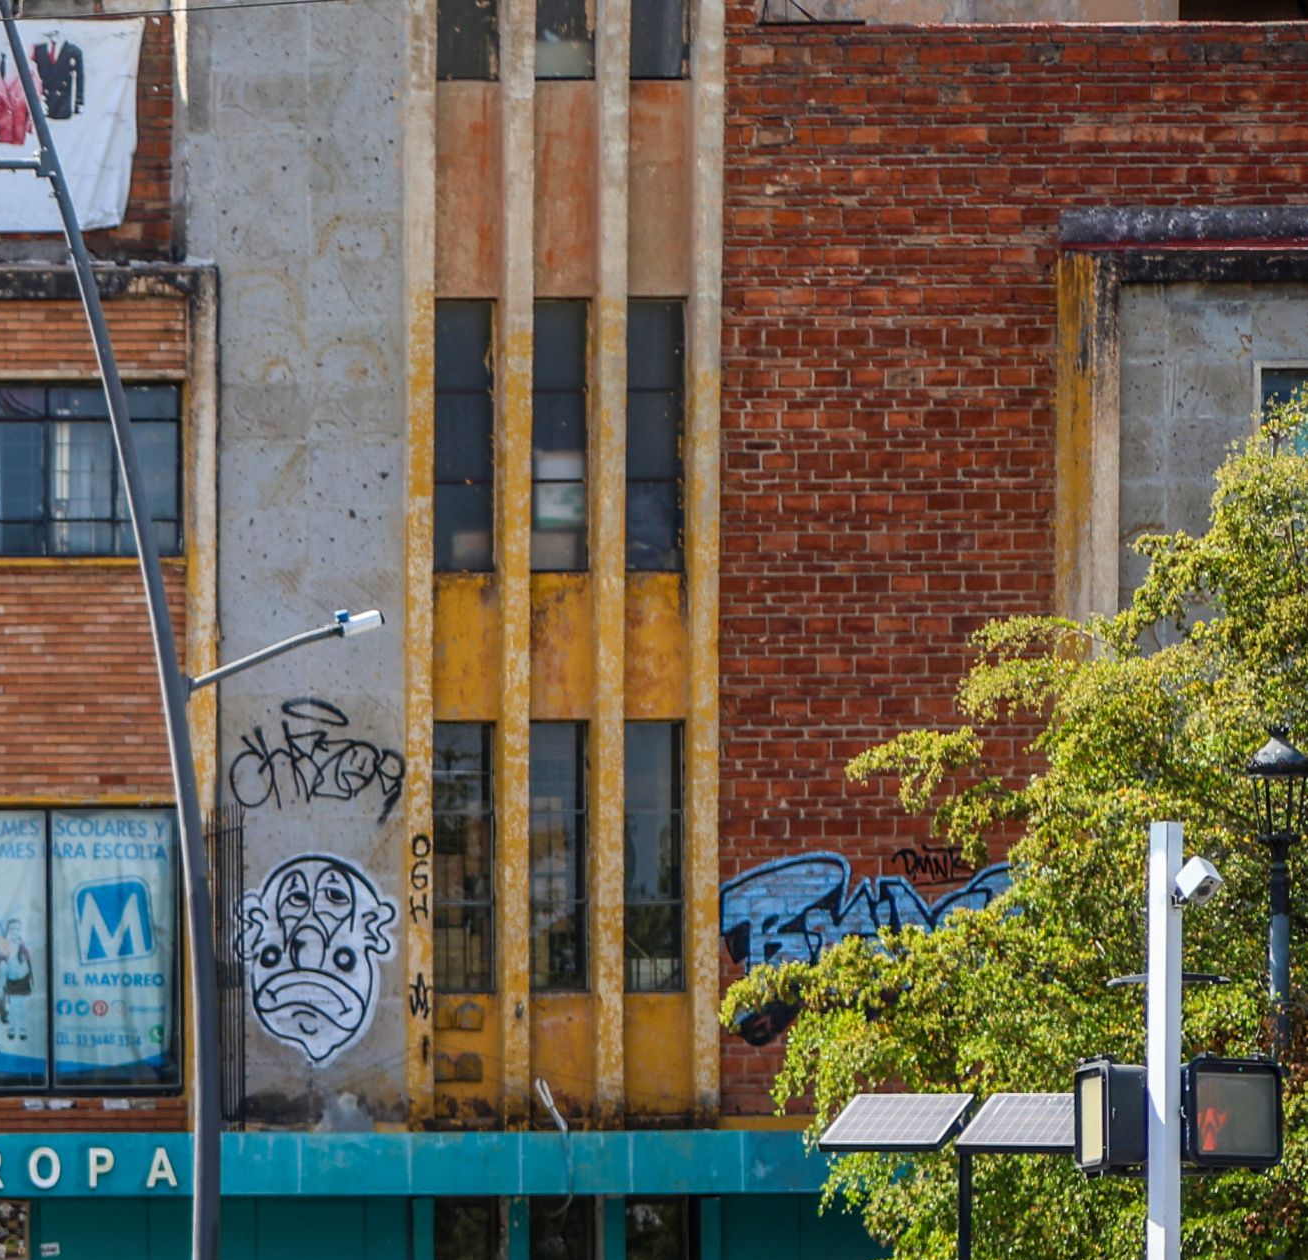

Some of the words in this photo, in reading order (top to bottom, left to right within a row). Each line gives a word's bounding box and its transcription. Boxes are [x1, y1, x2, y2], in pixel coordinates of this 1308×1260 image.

[53, 818, 148, 838] SCOLARES
[63, 973, 78, 986] EL
[84, 973, 165, 987] MAYOREO
